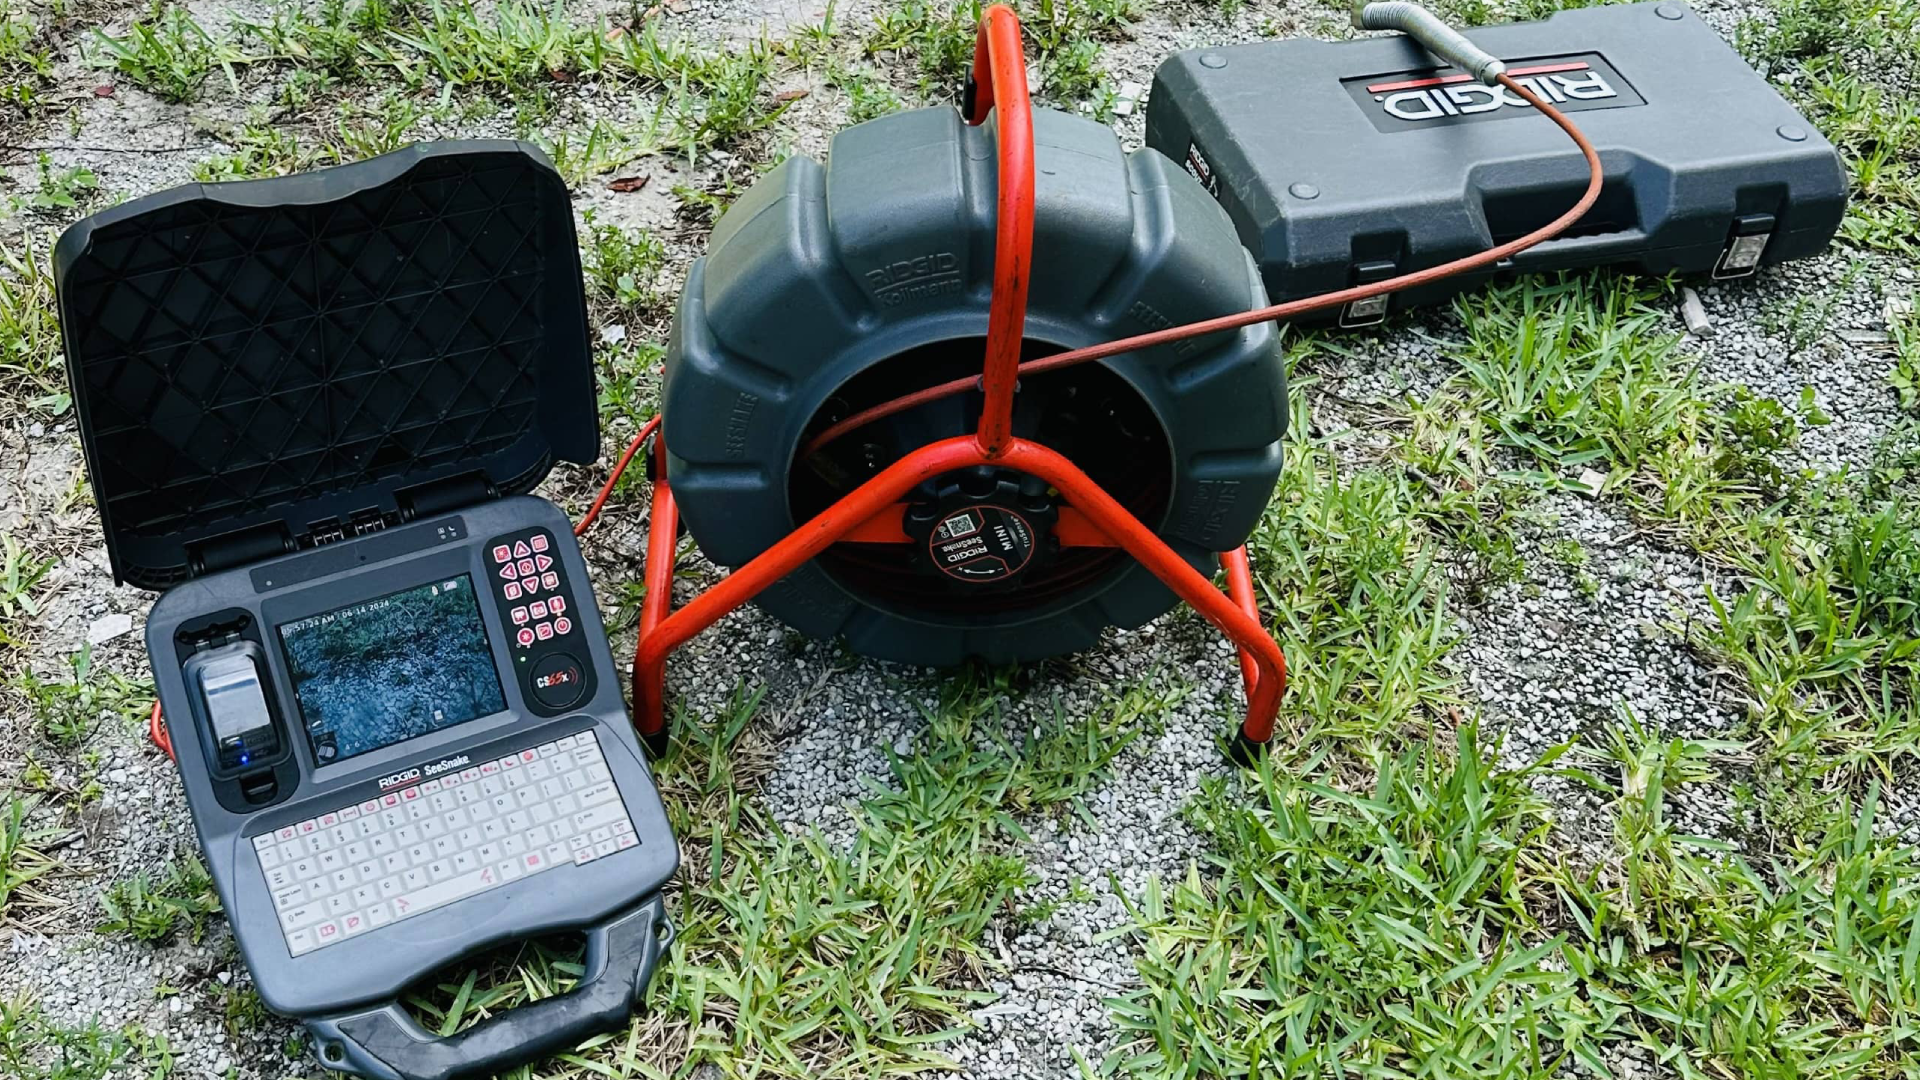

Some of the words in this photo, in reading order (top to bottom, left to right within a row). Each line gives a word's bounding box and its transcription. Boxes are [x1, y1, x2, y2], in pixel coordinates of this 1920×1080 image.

[863, 251, 960, 291] RIDGID
[941, 536, 984, 552] SeeSnake
[993, 525, 1014, 551] MINI
[947, 546, 988, 563] RIDGID
[321, 614, 335, 625] AM
[536, 671, 570, 689] CS65x
[378, 768, 421, 788] RIDGID
[424, 755, 470, 776] SeeSnake
